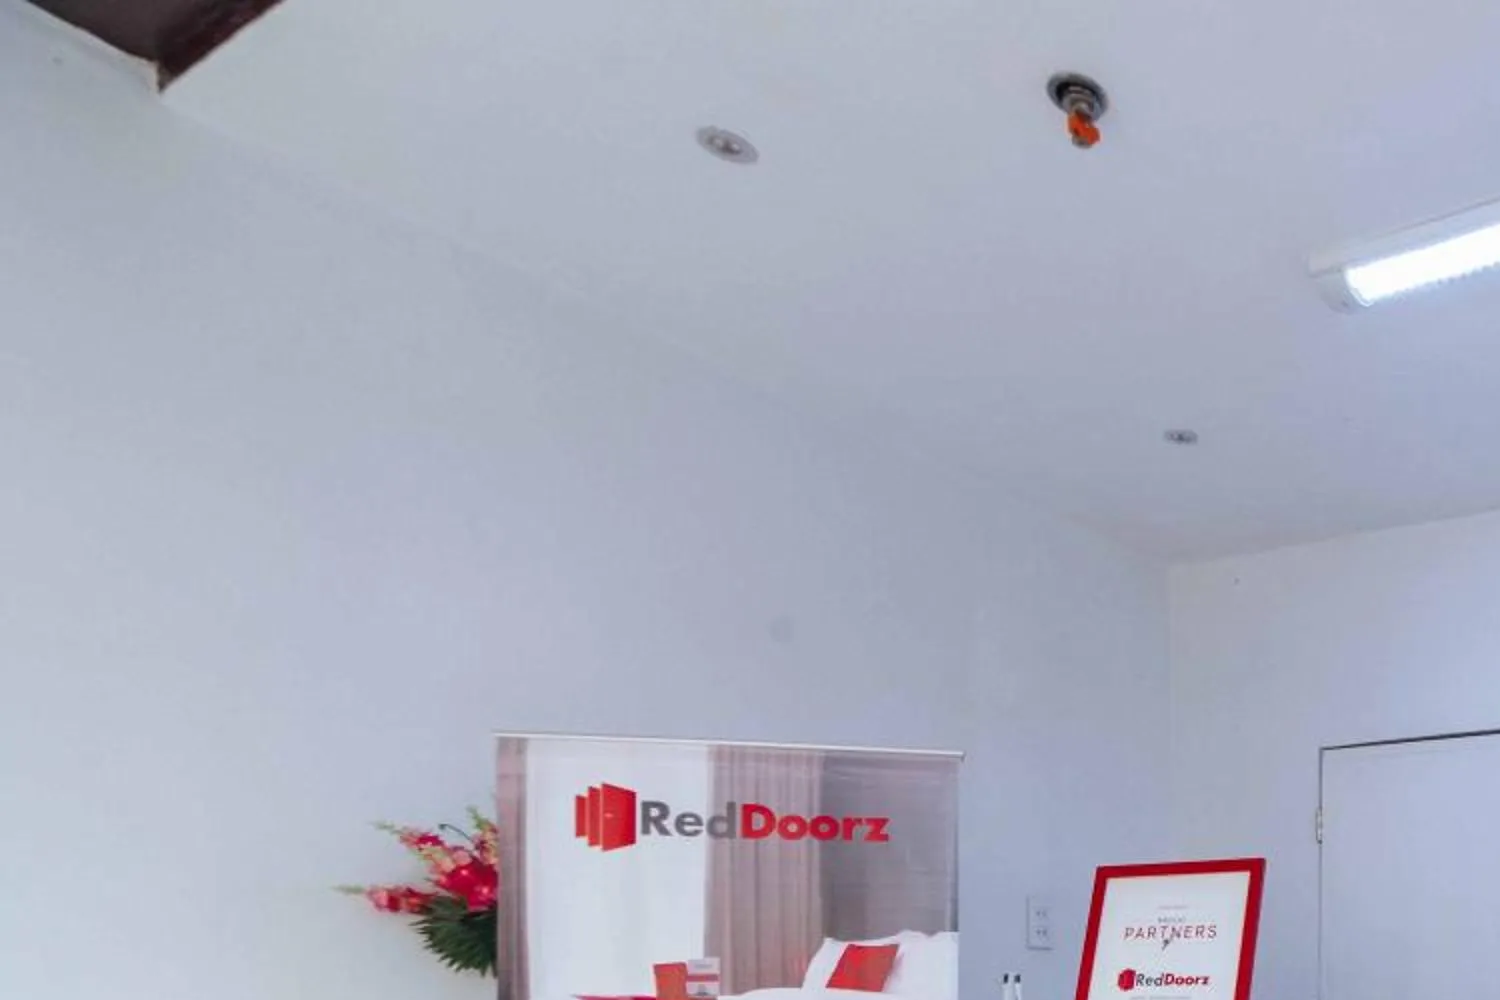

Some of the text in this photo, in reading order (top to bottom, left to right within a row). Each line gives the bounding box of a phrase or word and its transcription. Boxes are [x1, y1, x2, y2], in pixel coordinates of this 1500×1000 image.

[641, 801, 890, 843] RedDoorz
[1124, 924, 1217, 939] PARTNERS
[1136, 972, 1210, 986] RedDoorz
